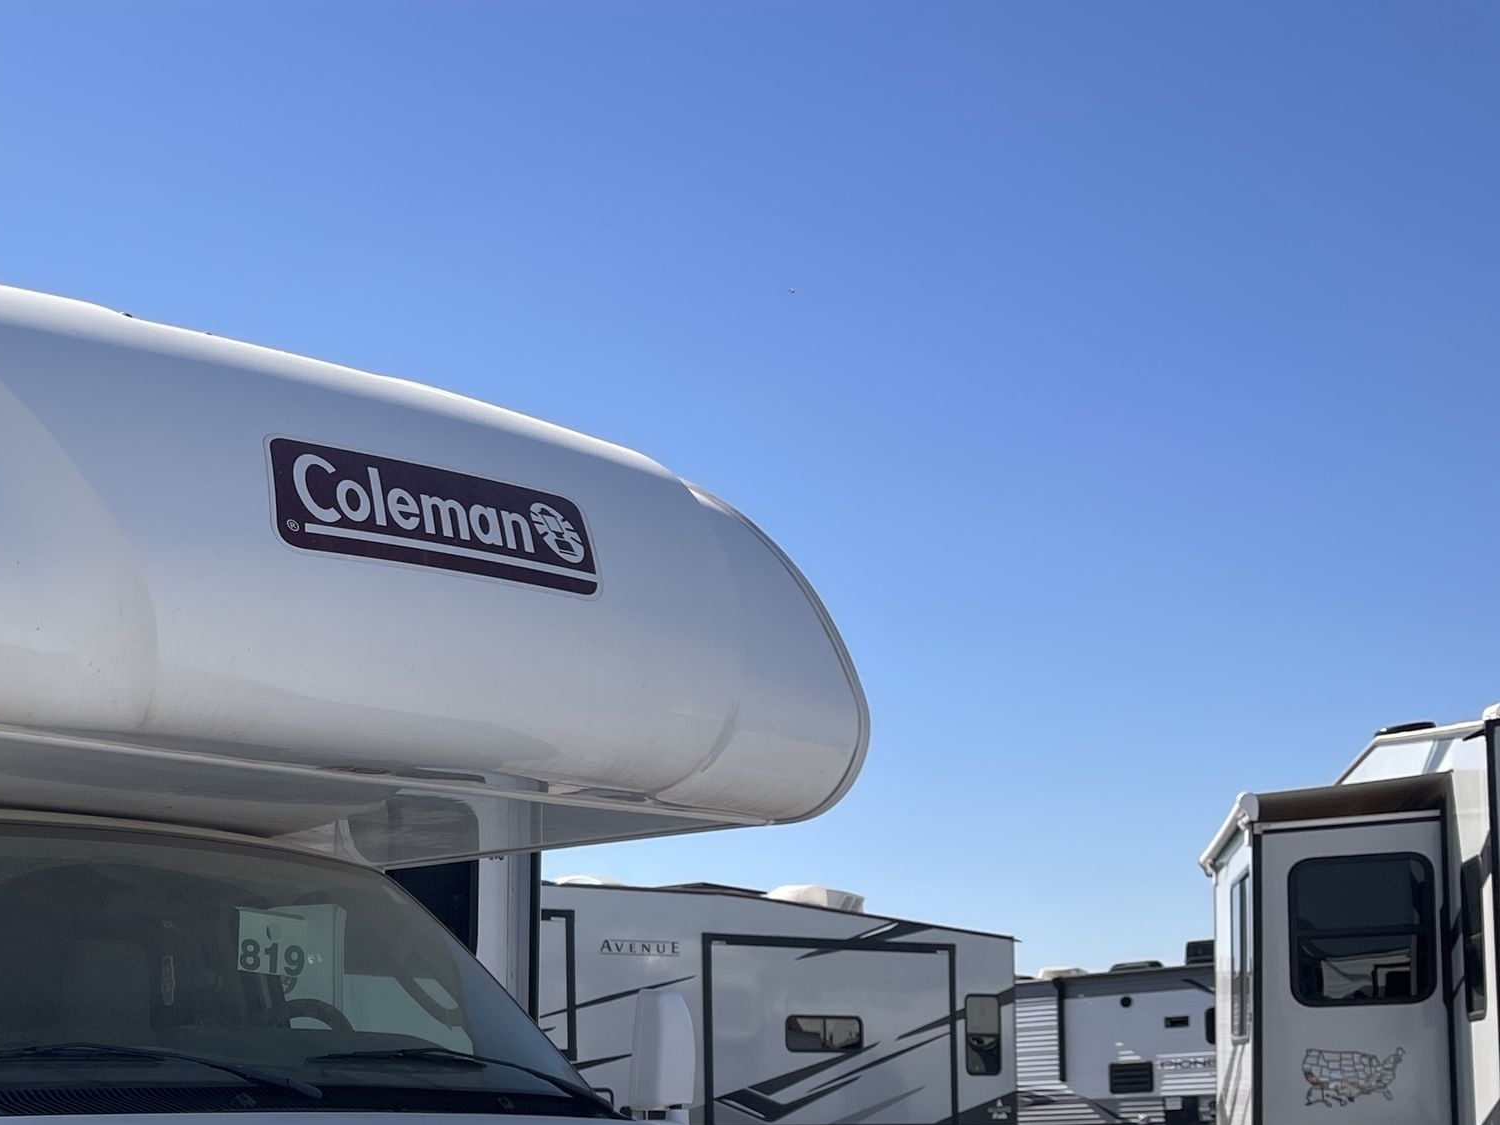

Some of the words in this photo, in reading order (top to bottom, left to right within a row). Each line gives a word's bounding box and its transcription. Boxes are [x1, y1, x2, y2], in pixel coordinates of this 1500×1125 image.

[292, 452, 536, 554] Coleman
[239, 938, 305, 977] 819
[600, 939, 680, 954] AVENUE
